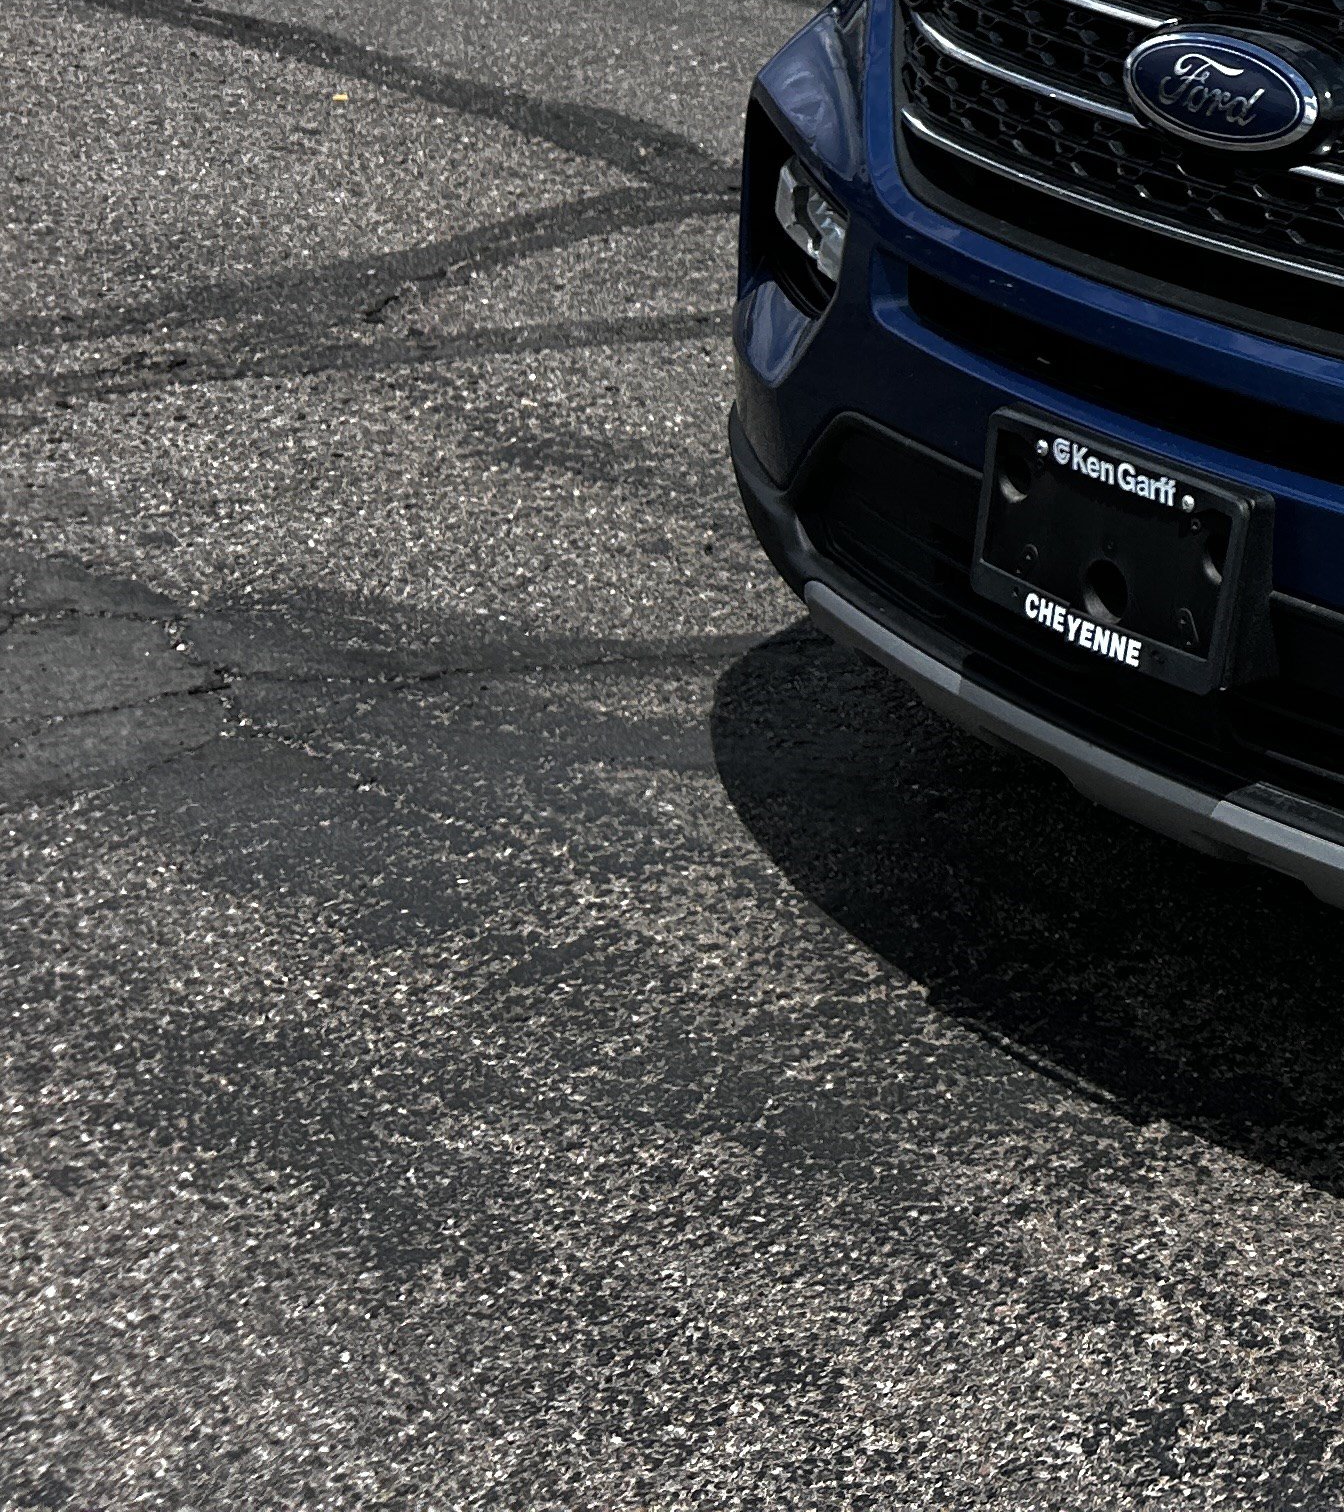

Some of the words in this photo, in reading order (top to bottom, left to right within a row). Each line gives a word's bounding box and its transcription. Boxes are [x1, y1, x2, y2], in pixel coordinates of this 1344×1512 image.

[1157, 52, 1266, 127] Ford
[1072, 442, 1115, 485] Ken
[1116, 461, 1177, 508] Garff
[1023, 591, 1143, 669] CHEYENNE
